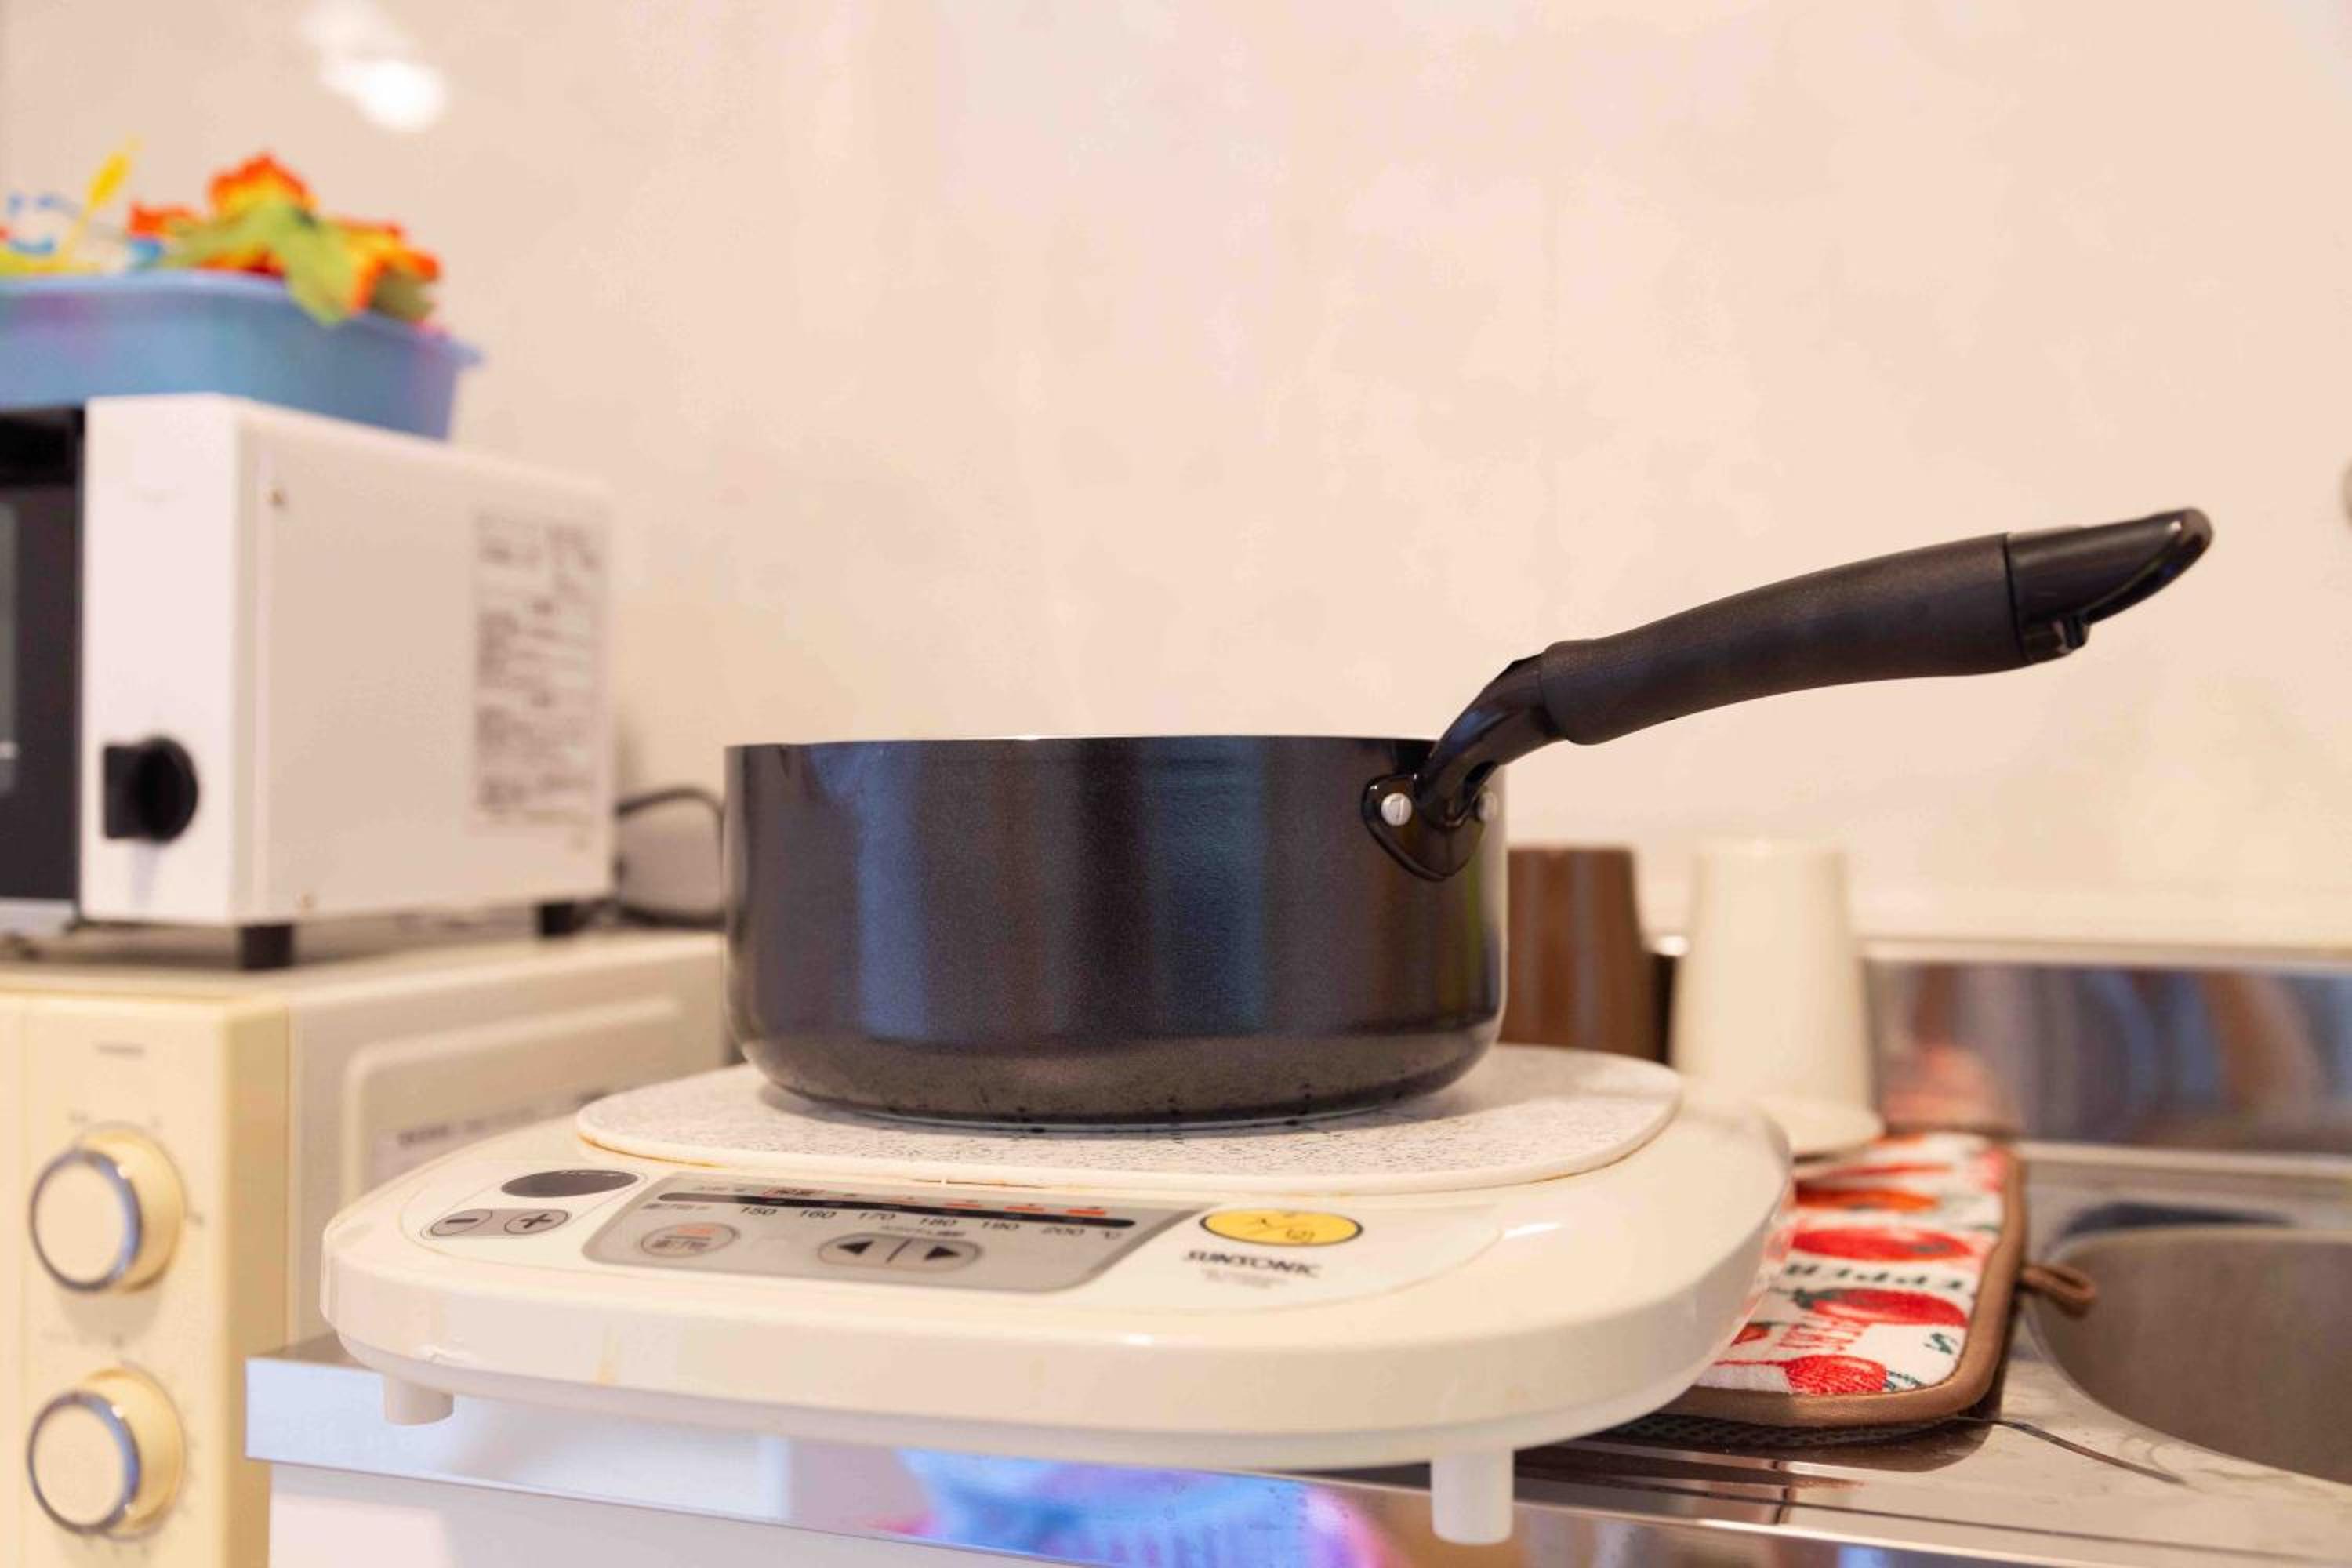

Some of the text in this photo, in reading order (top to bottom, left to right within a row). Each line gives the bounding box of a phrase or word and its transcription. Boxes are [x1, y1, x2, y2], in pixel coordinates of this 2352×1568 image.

[739, 1206, 778, 1216] 150
[799, 1209, 837, 1220] 160
[858, 1212, 897, 1221] 170
[919, 1217, 959, 1228] 180
[1043, 1226, 1086, 1236] 200
[1784, 1263, 1969, 1292] EPPER
